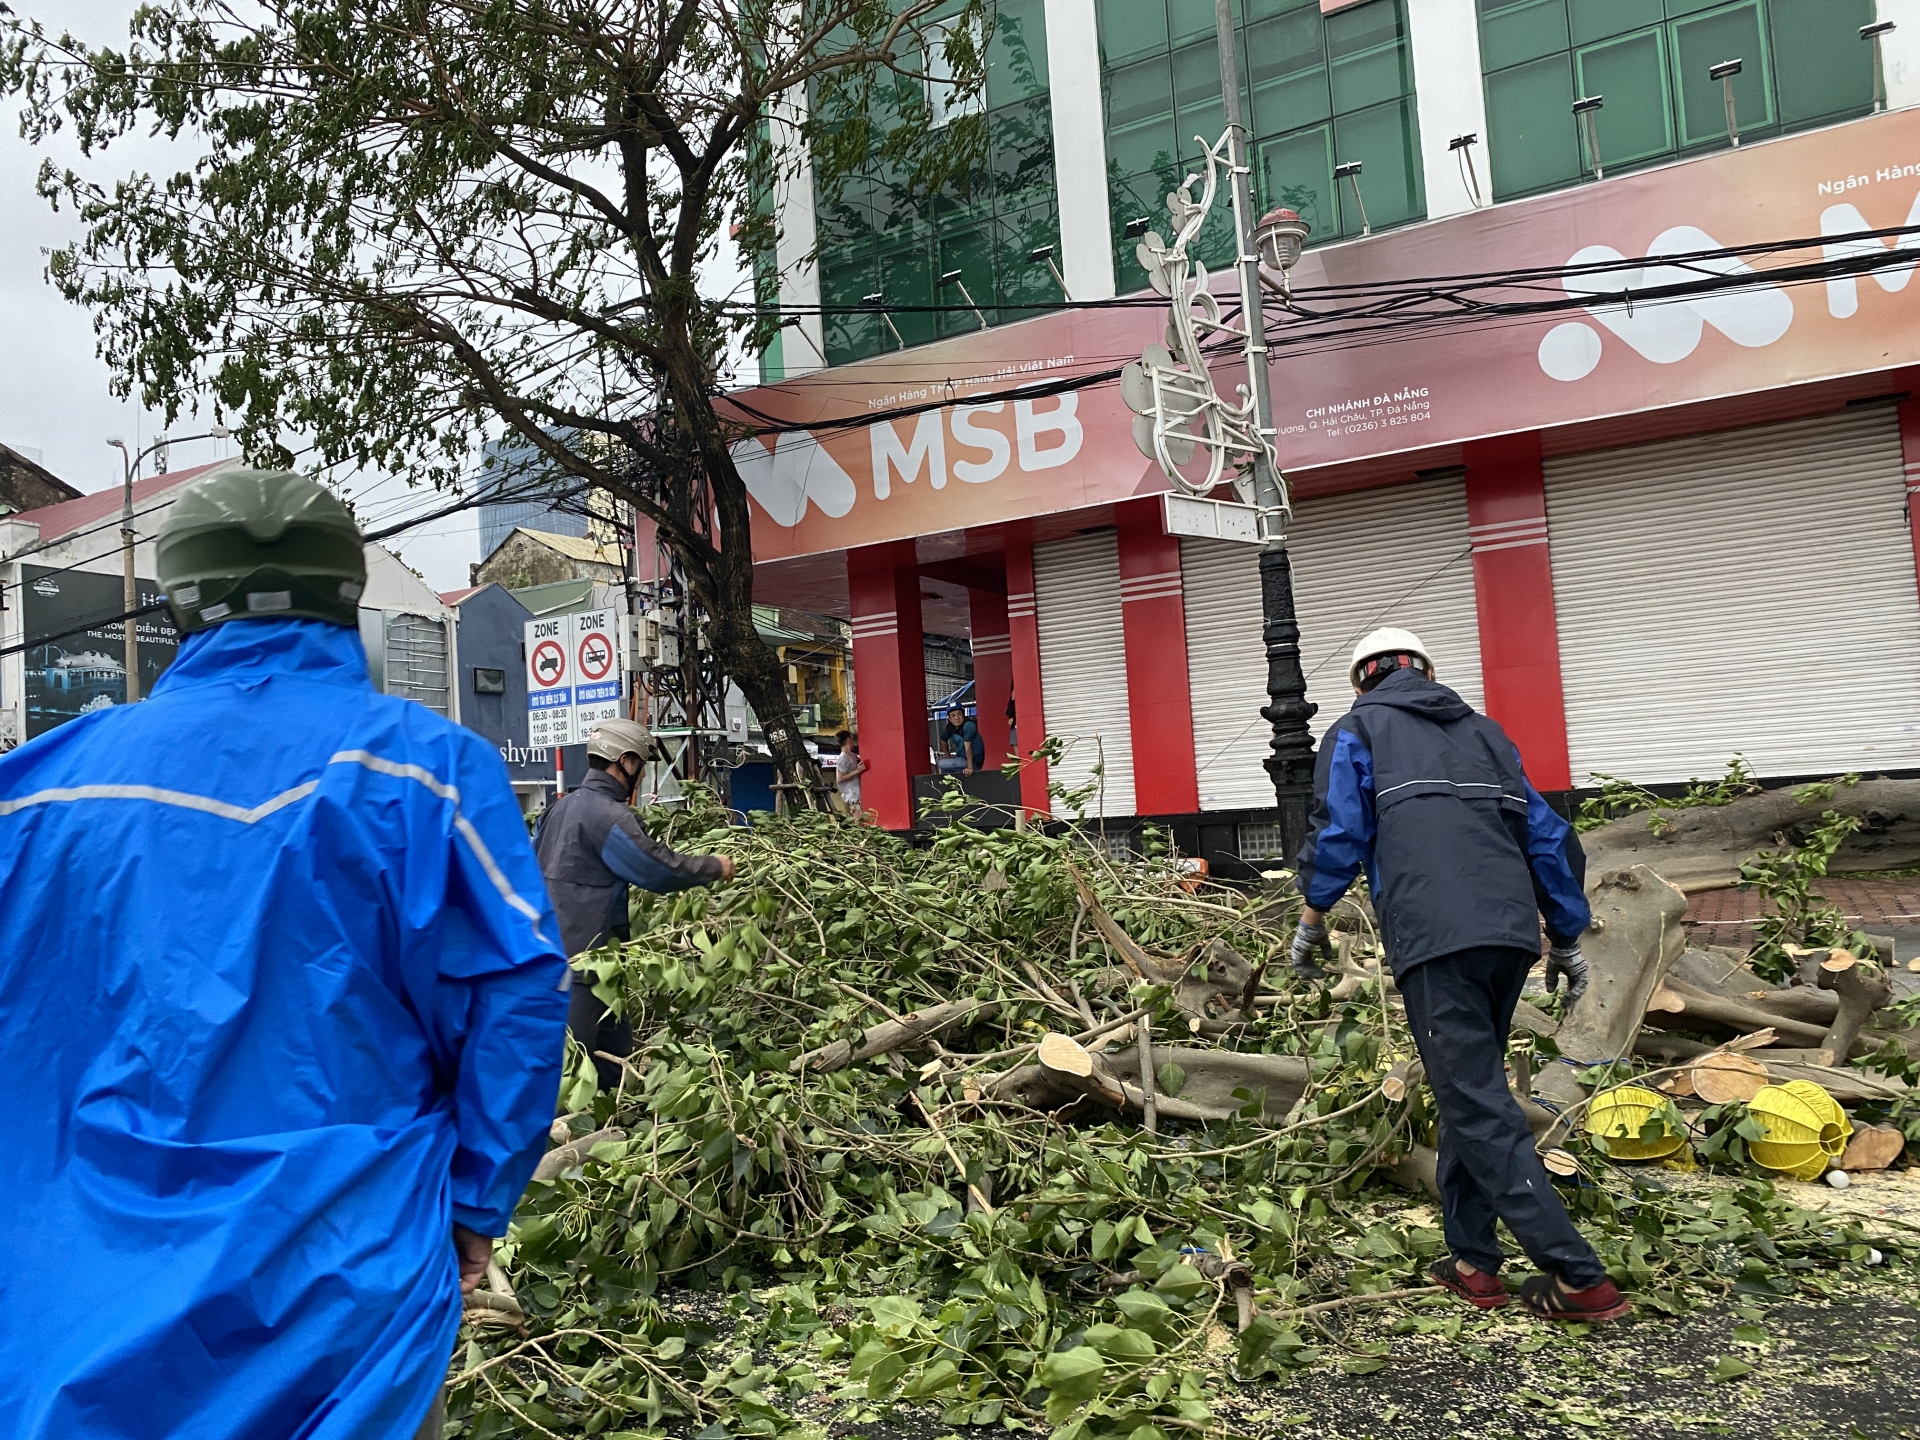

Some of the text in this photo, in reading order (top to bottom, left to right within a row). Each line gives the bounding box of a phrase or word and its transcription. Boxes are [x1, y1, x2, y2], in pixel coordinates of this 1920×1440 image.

[1818, 174, 1870, 196] Ngân
[868, 395, 898, 409] Ngân
[899, 388, 927, 402] Hàng
[997, 366, 1016, 379] Hải
[1020, 361, 1043, 376] Việt
[1048, 354, 1074, 368] Nam
[1306, 386, 1429, 418] CHI NHÁNH ĐÀ NẴNG
[1309, 421, 1320, 430] Q.
[1322, 417, 1338, 427] Hải
[1340, 412, 1368, 424] Châu,
[1370, 409, 1384, 418] TP.
[1387, 405, 1401, 416] Đà
[1326, 411, 1430, 438] Tel: (0236) 3 825 804
[869, 377, 1084, 500] MSB
[534, 622, 558, 638] ZONE
[580, 613, 605, 630] ZONE
[104, 632, 126, 640] MOST
[136, 636, 174, 645] BEAUTIFUL
[580, 712, 595, 722] 10:30
[601, 709, 616, 719] 12:00
[533, 724, 548, 734] 11:00
[552, 721, 567, 731] 12:00
[553, 733, 568, 743] 19:00
